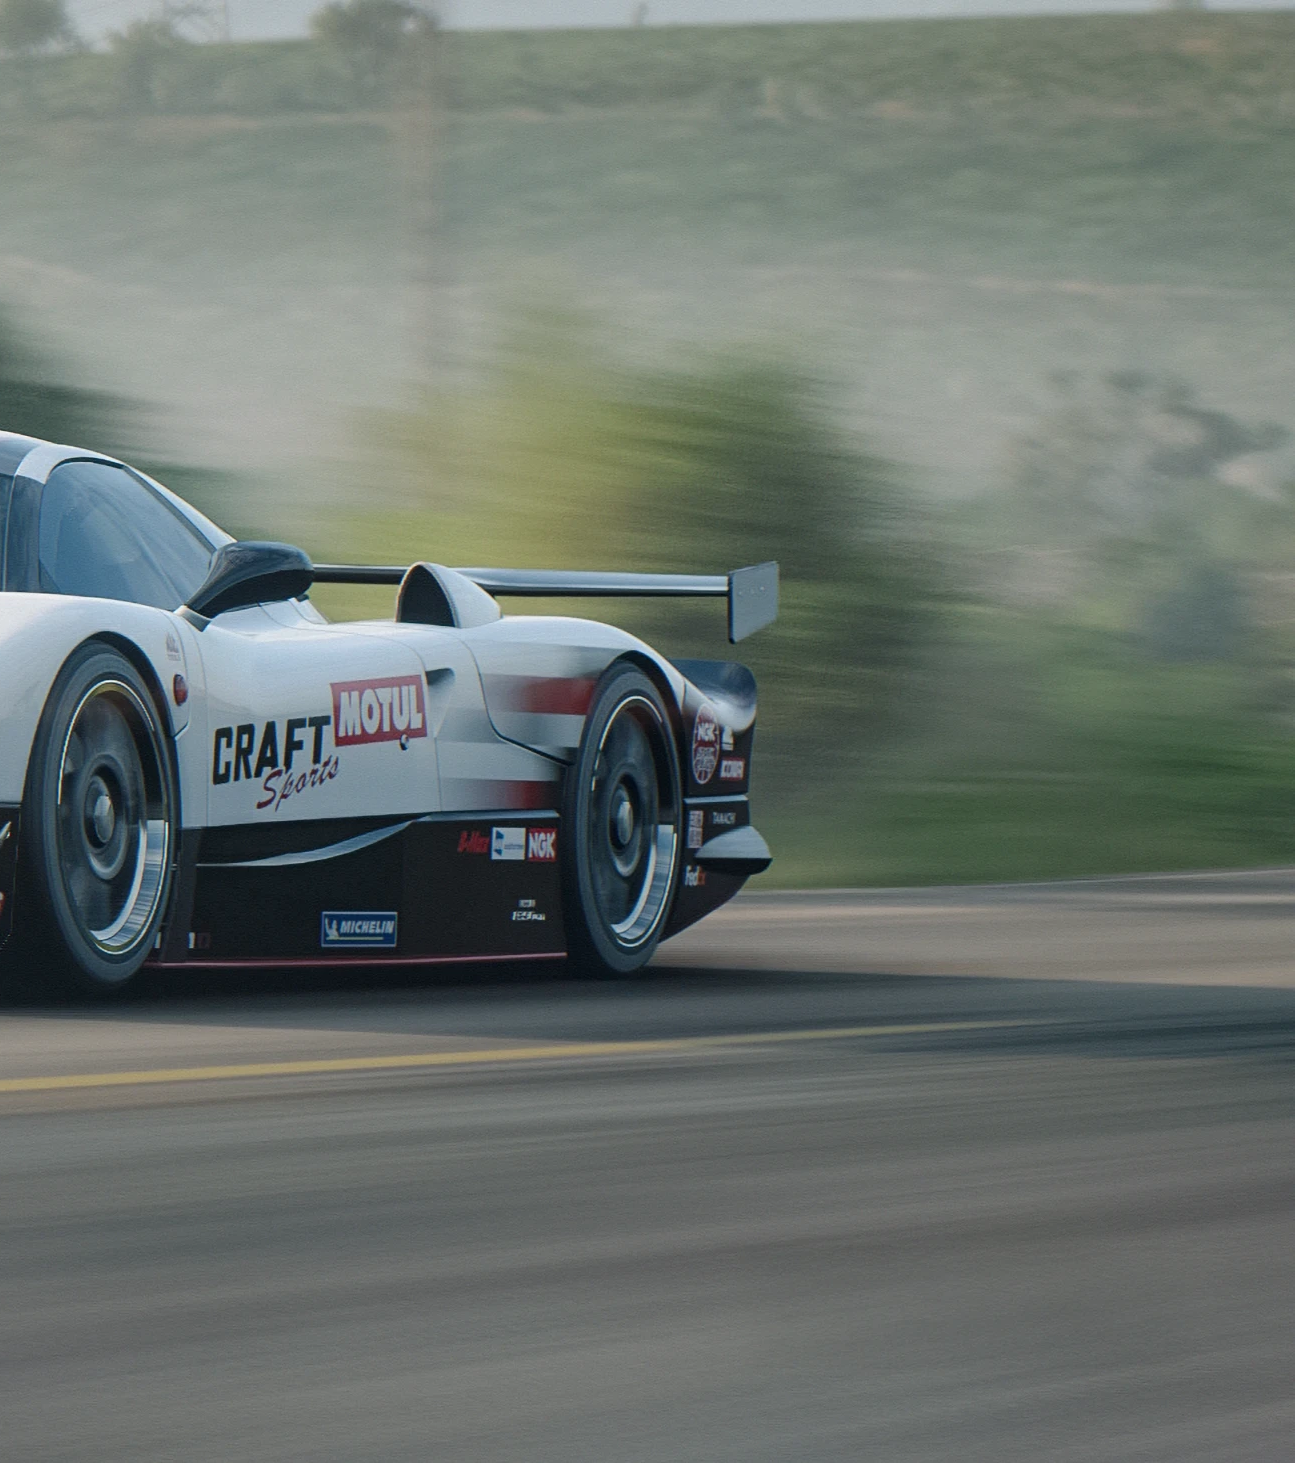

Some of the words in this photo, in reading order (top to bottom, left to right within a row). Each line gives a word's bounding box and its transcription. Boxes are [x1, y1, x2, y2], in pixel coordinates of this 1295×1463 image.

[338, 684, 423, 738] MOTUL
[212, 715, 331, 785] CRAFT
[256, 754, 340, 812] Sports
[528, 832, 556, 858] NGK
[340, 920, 395, 934] MICHELIN
